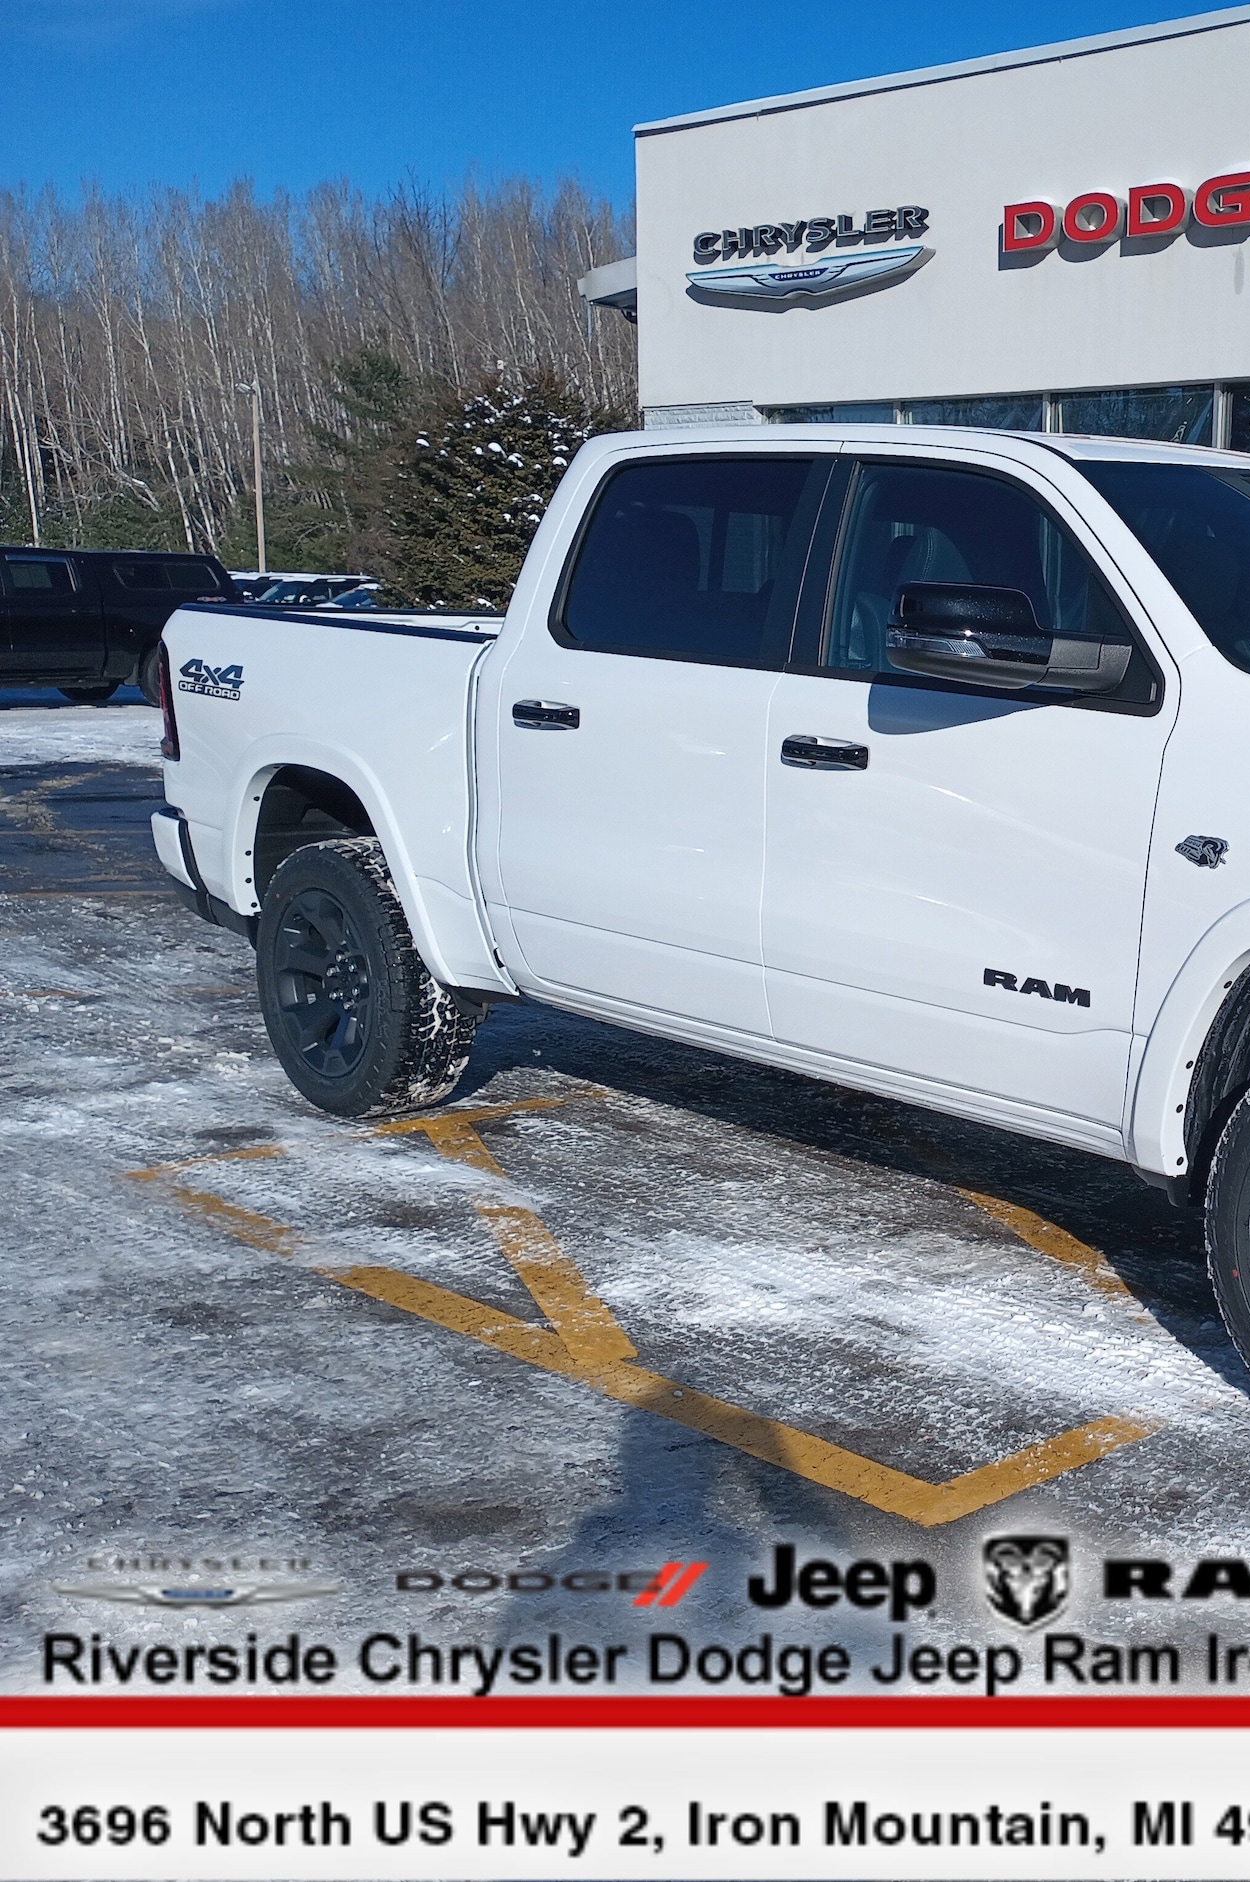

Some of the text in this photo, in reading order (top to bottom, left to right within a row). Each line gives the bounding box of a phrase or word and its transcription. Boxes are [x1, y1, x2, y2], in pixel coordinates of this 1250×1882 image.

[693, 205, 927, 258] CHRYSLER
[774, 270, 820, 280] CHRYSLER
[179, 658, 245, 689] 4x4
[179, 681, 240, 700] OFF ROAD
[983, 967, 1091, 1008] RAM
